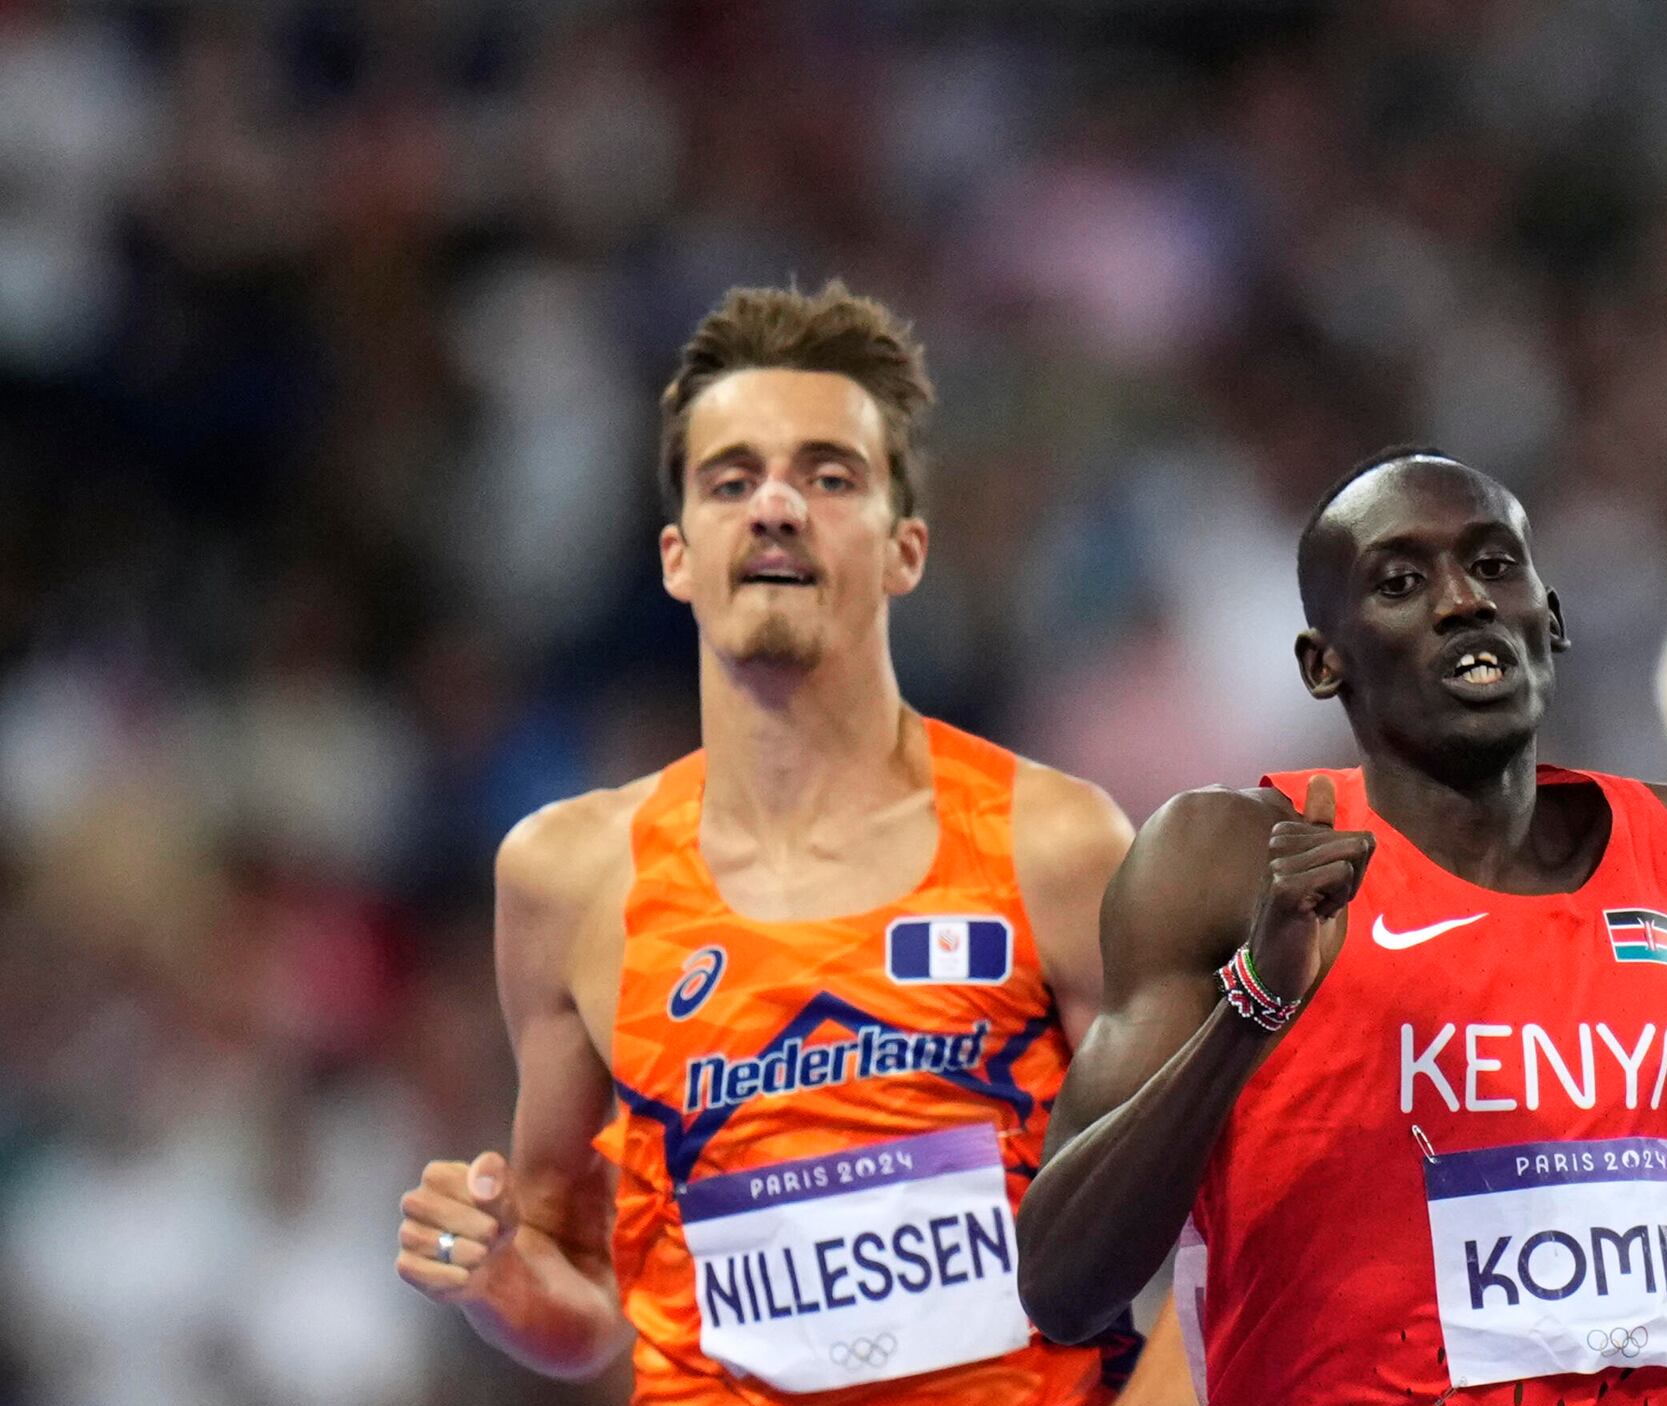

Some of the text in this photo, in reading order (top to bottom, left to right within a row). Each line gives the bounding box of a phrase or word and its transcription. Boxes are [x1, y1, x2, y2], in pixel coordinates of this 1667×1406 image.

[750, 1151, 913, 1199] PARIS 2024
[1516, 1150, 1667, 1177] PARIS 2024
[705, 1206, 1012, 1328] NILLESSEN
